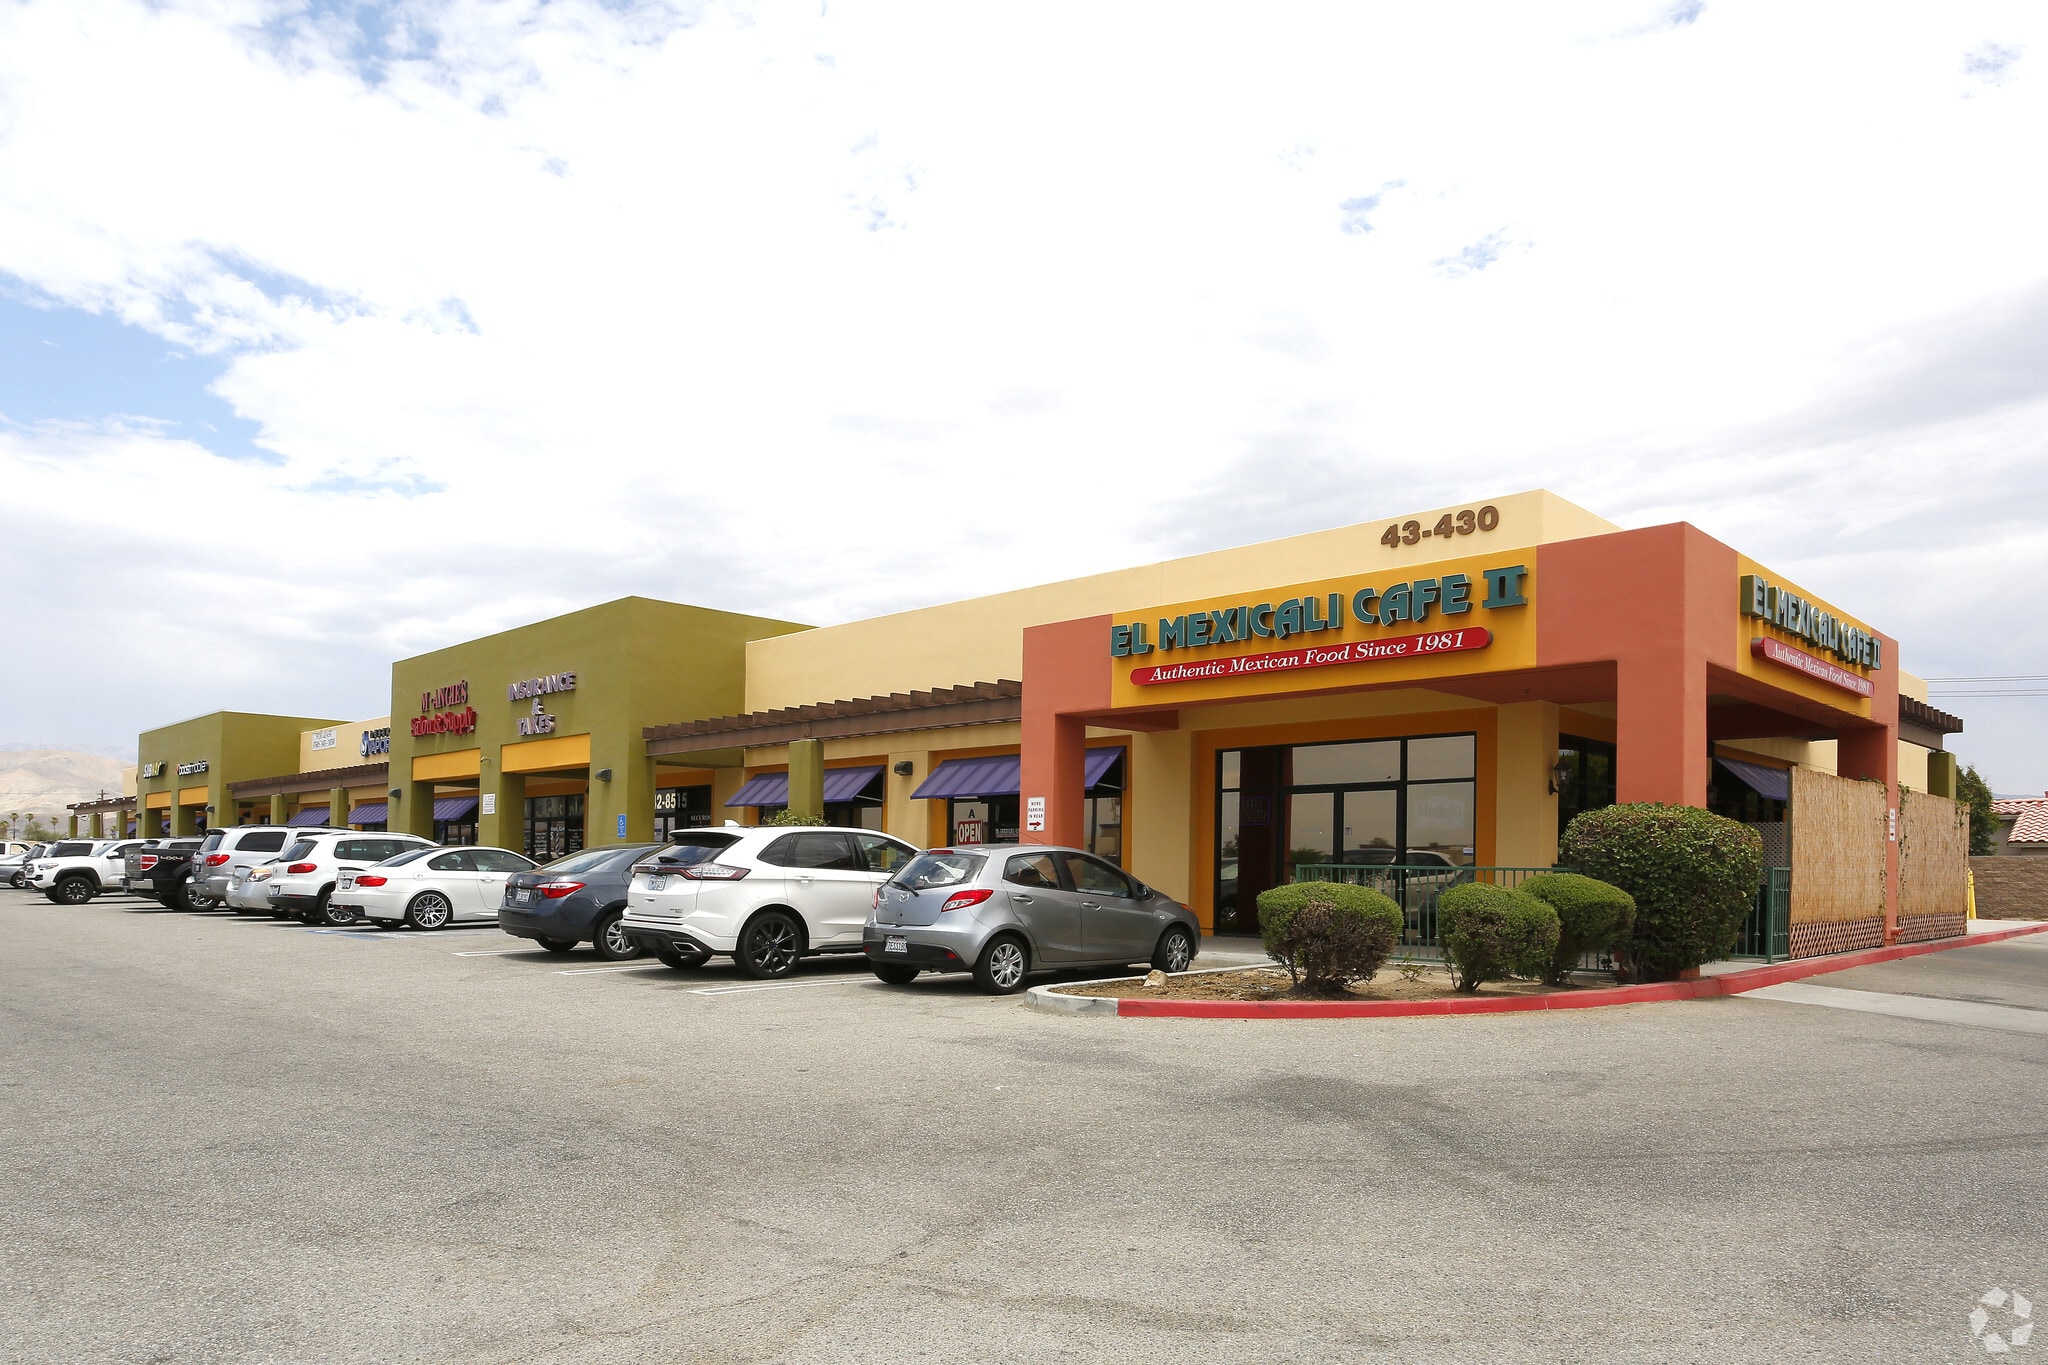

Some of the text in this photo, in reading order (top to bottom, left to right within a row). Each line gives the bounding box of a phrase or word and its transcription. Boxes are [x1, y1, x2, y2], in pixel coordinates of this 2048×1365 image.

[1381, 506, 1499, 548] 43-430
[1111, 565, 1528, 657] EL MEXICALI CAFE II
[1750, 574, 1882, 670] EL MEXICALI CAFE II
[1149, 631, 1464, 682] Authentic Mexican Food Since 1981
[1772, 644, 1870, 695] Authentic Mexican Food Since 1981
[508, 671, 576, 702] INSURANCE
[443, 706, 478, 735] Supply
[531, 697, 544, 716] &
[517, 714, 556, 736] TAXES
[968, 808, 976, 819] A
[958, 822, 981, 843] OPEN
